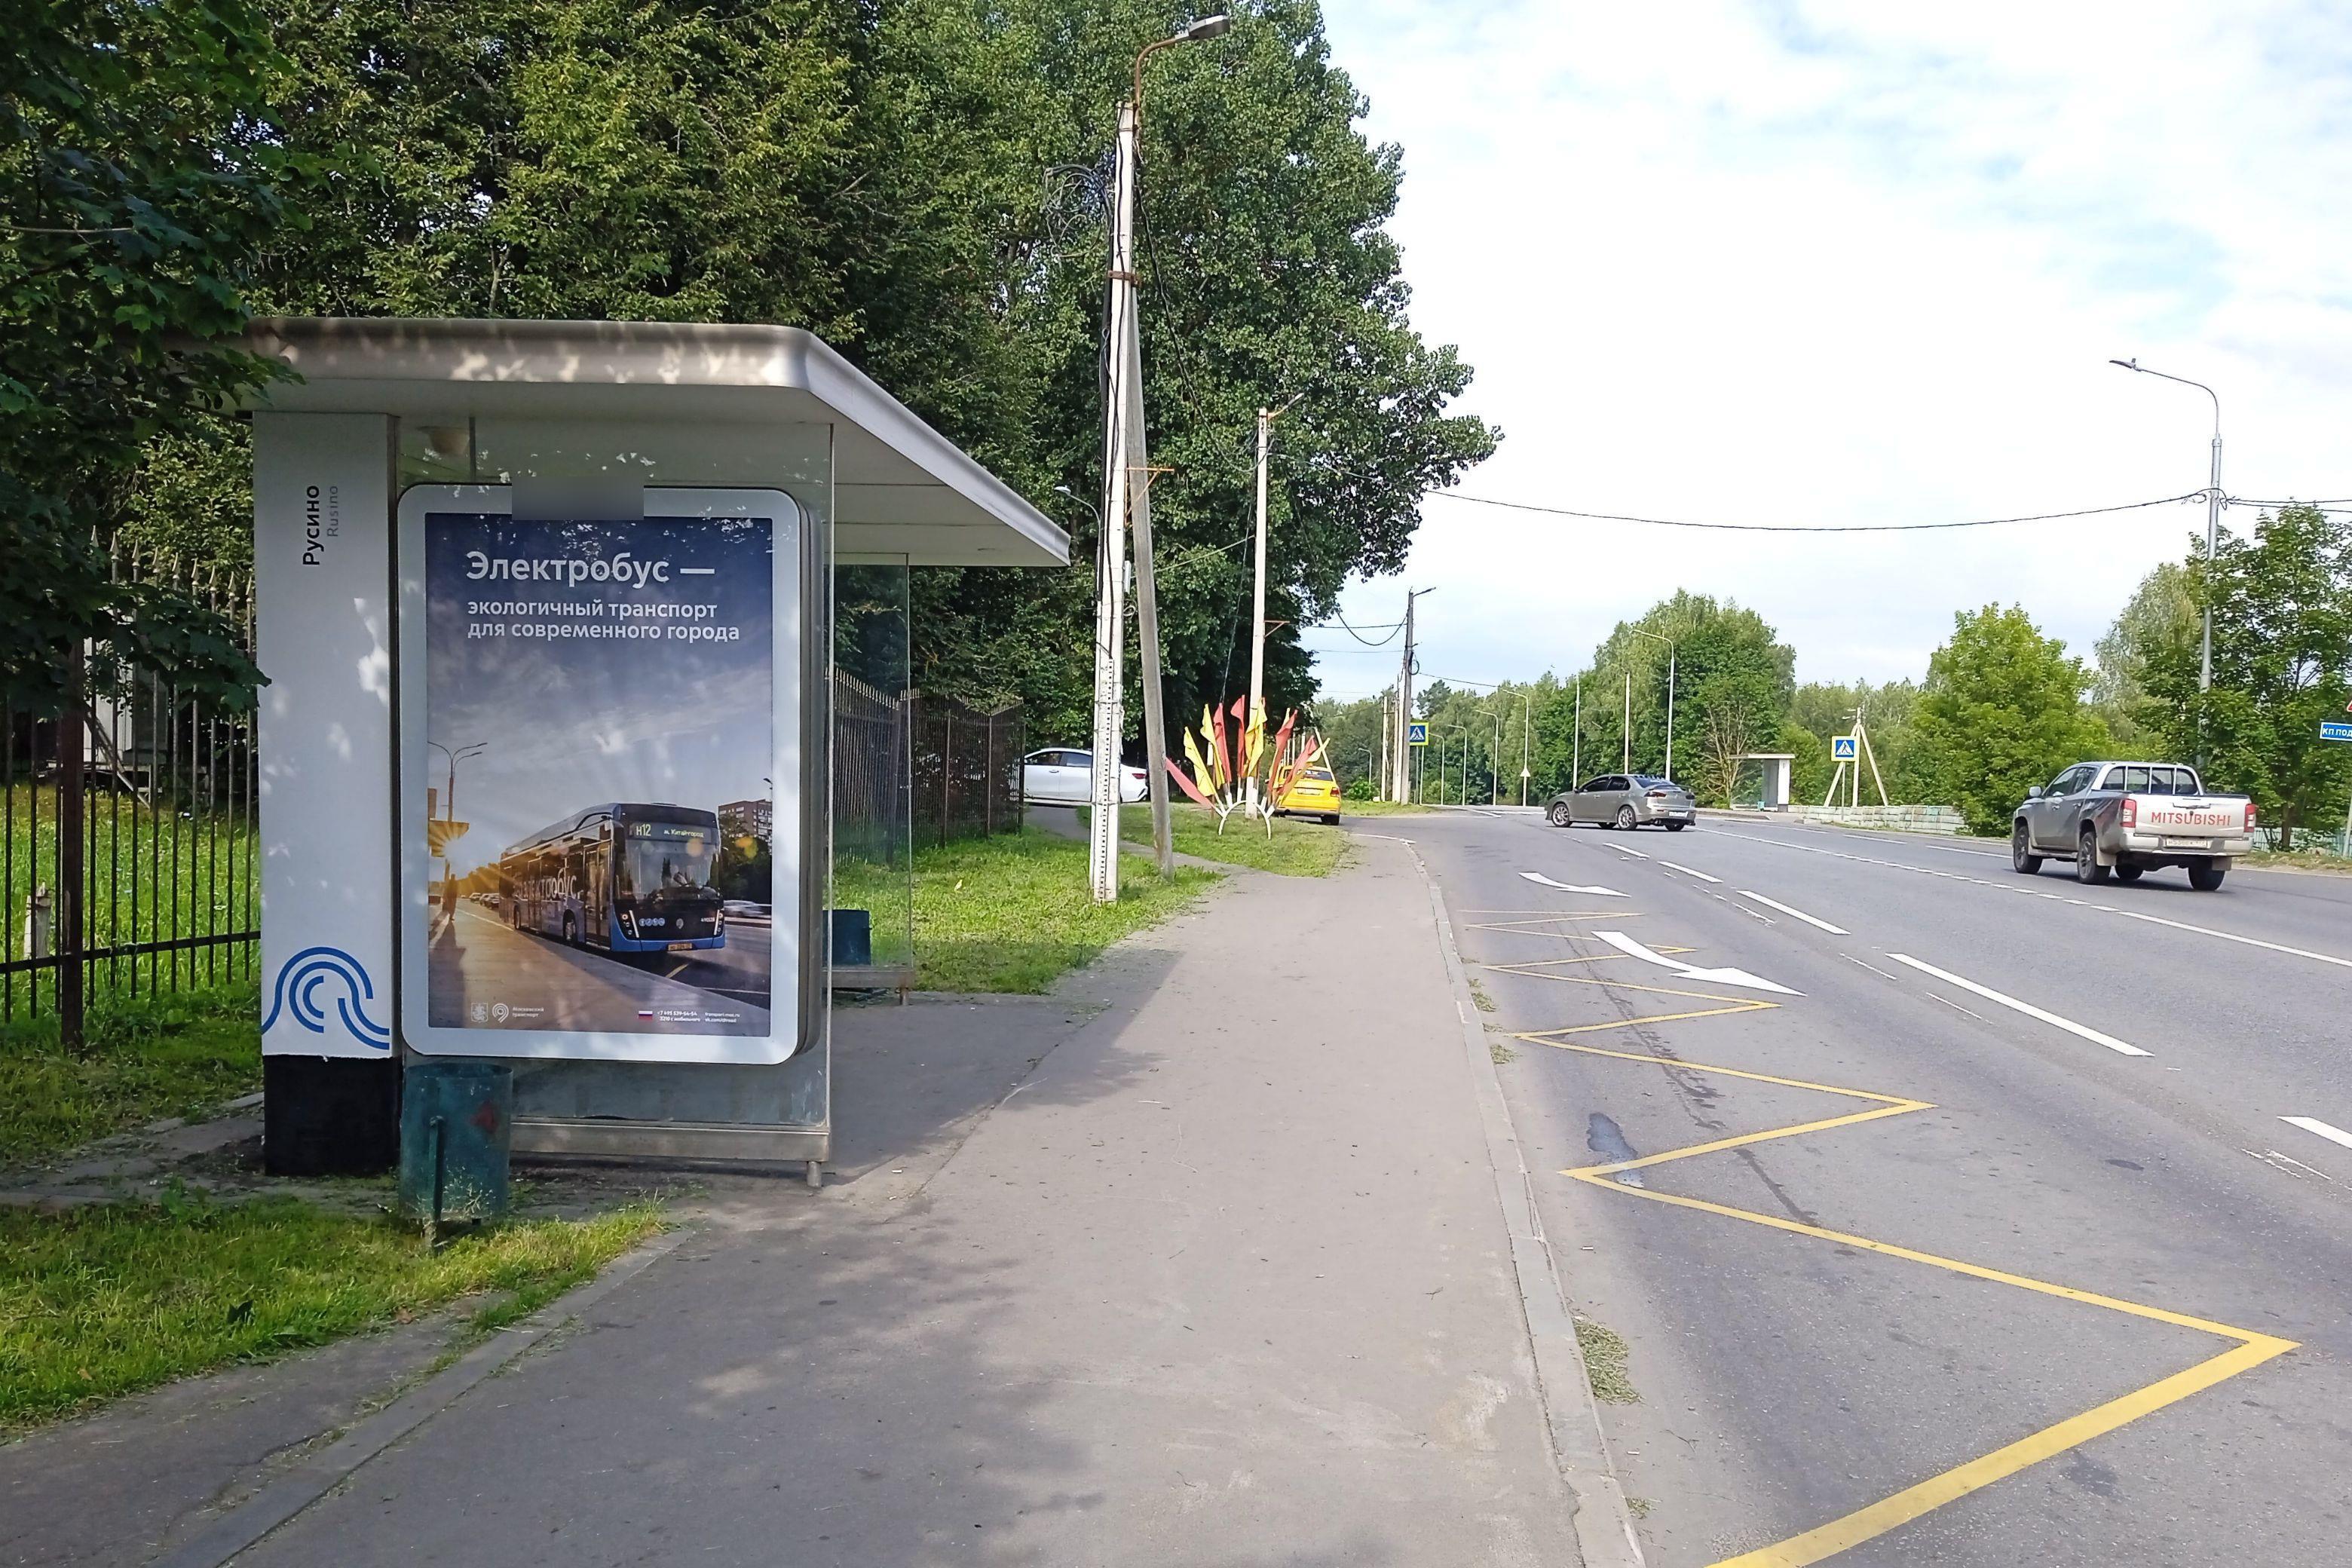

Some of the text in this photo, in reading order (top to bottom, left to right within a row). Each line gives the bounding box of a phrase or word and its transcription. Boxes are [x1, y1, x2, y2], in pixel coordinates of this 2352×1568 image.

[326, 486, 338, 537] Rusino
[302, 485, 324, 565] Русино
[466, 551, 669, 588] Электробус
[467, 599, 718, 620] экологичный транспорт
[467, 622, 740, 643] для современного города
[2323, 727, 2335, 736] КП
[2151, 812, 2231, 826] MITSUBISHI
